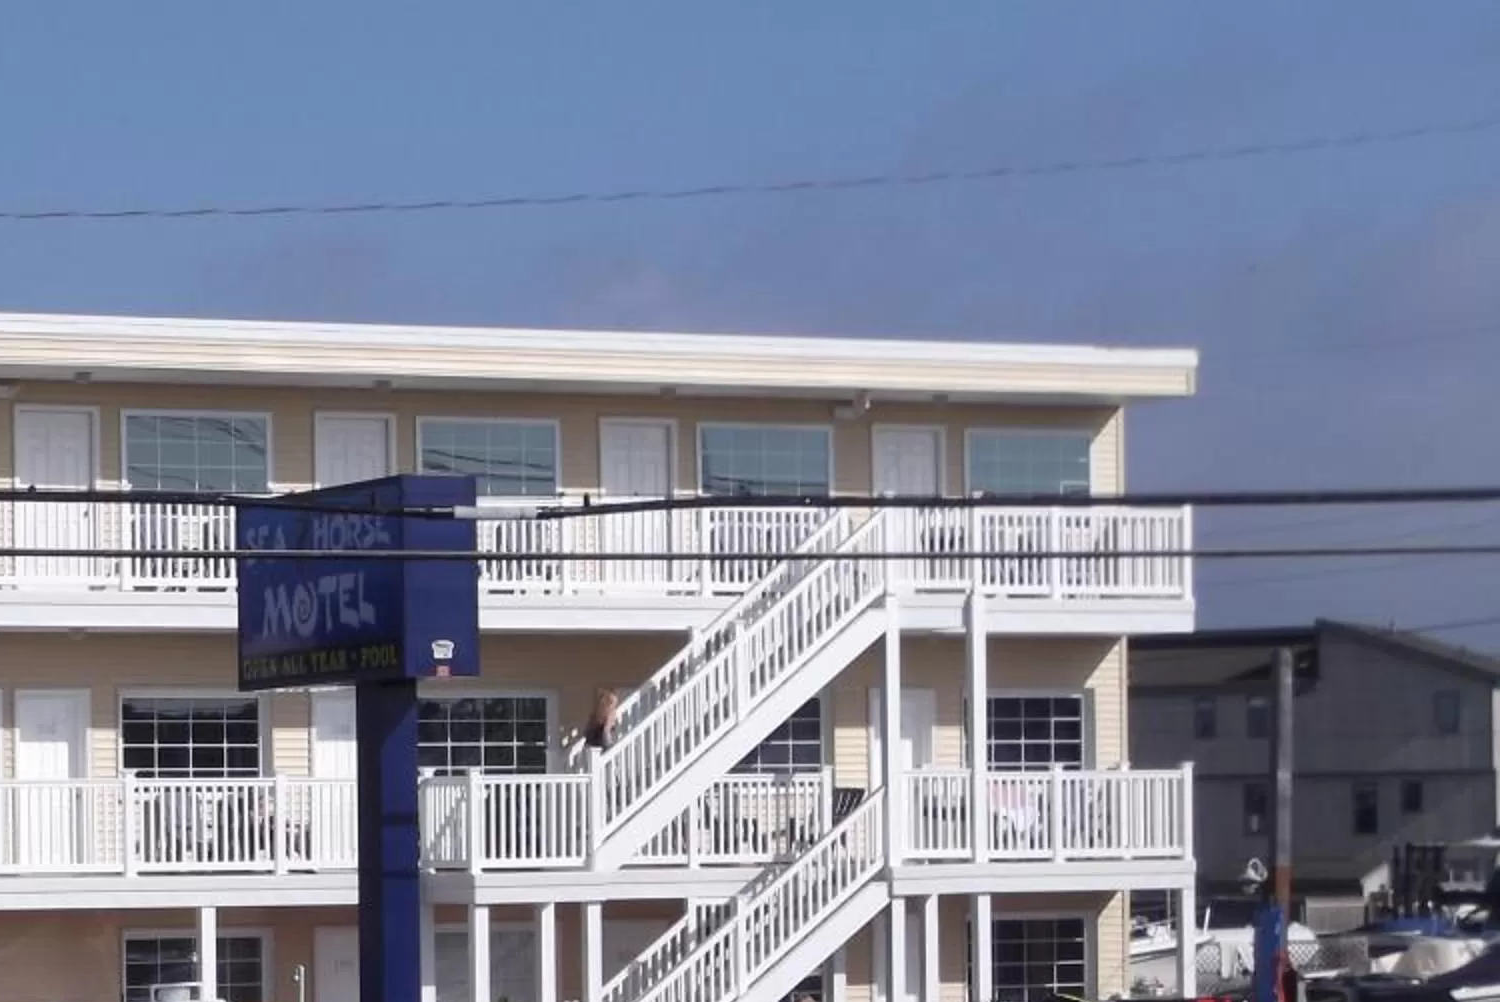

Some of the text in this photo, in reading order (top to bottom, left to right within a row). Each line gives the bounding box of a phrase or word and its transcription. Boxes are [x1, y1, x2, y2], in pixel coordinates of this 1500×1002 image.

[247, 512, 391, 565] SEA HORSE
[262, 571, 376, 640] MOTEL
[282, 654, 307, 675] ALL
